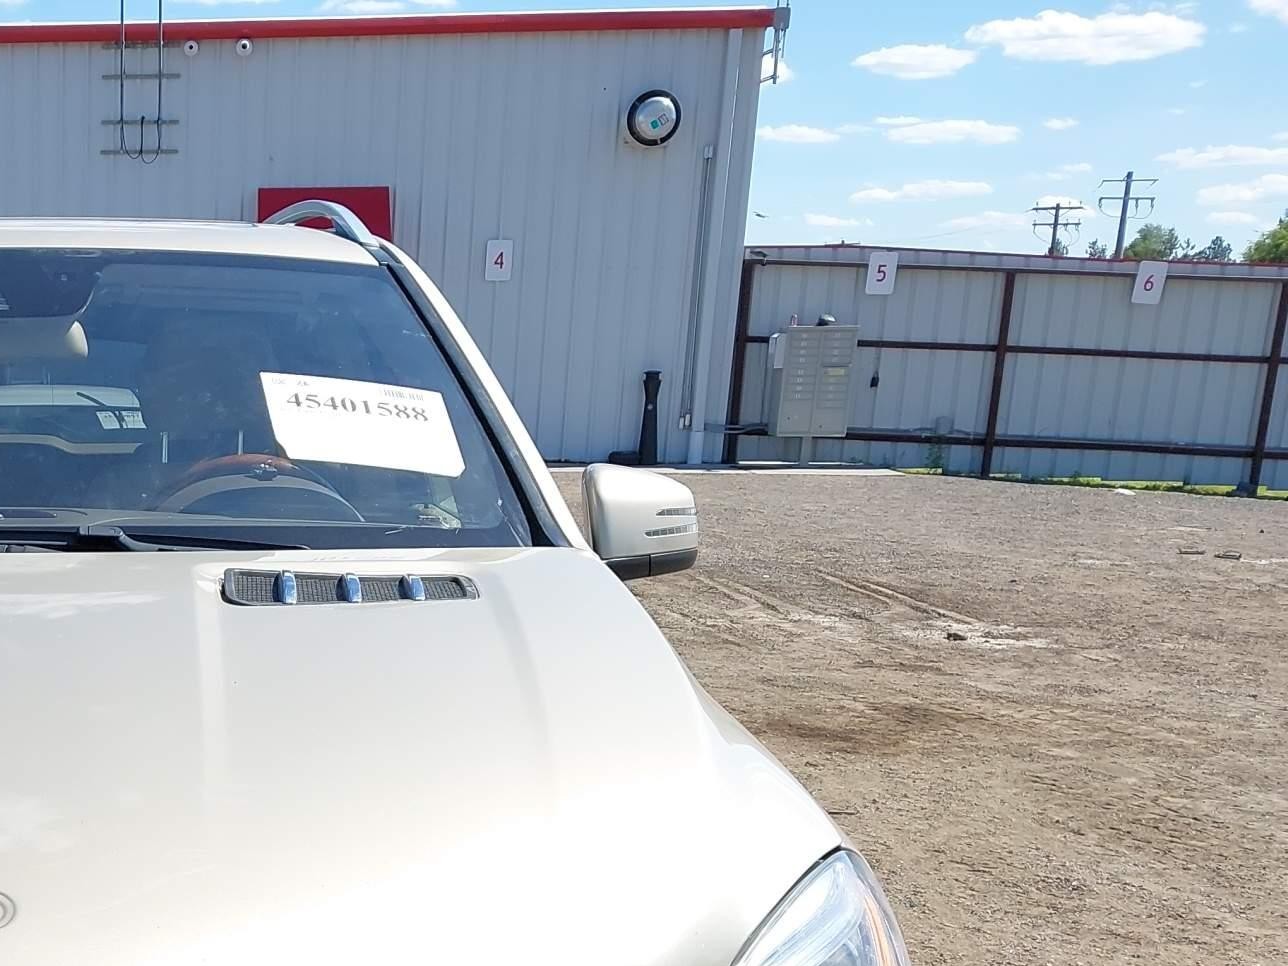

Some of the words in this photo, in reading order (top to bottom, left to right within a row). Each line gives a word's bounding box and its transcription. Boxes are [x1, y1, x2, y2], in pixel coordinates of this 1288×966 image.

[494, 252, 505, 273] 4
[875, 264, 888, 283] 5
[1143, 274, 1155, 292] 6
[286, 392, 429, 422] 45401588
